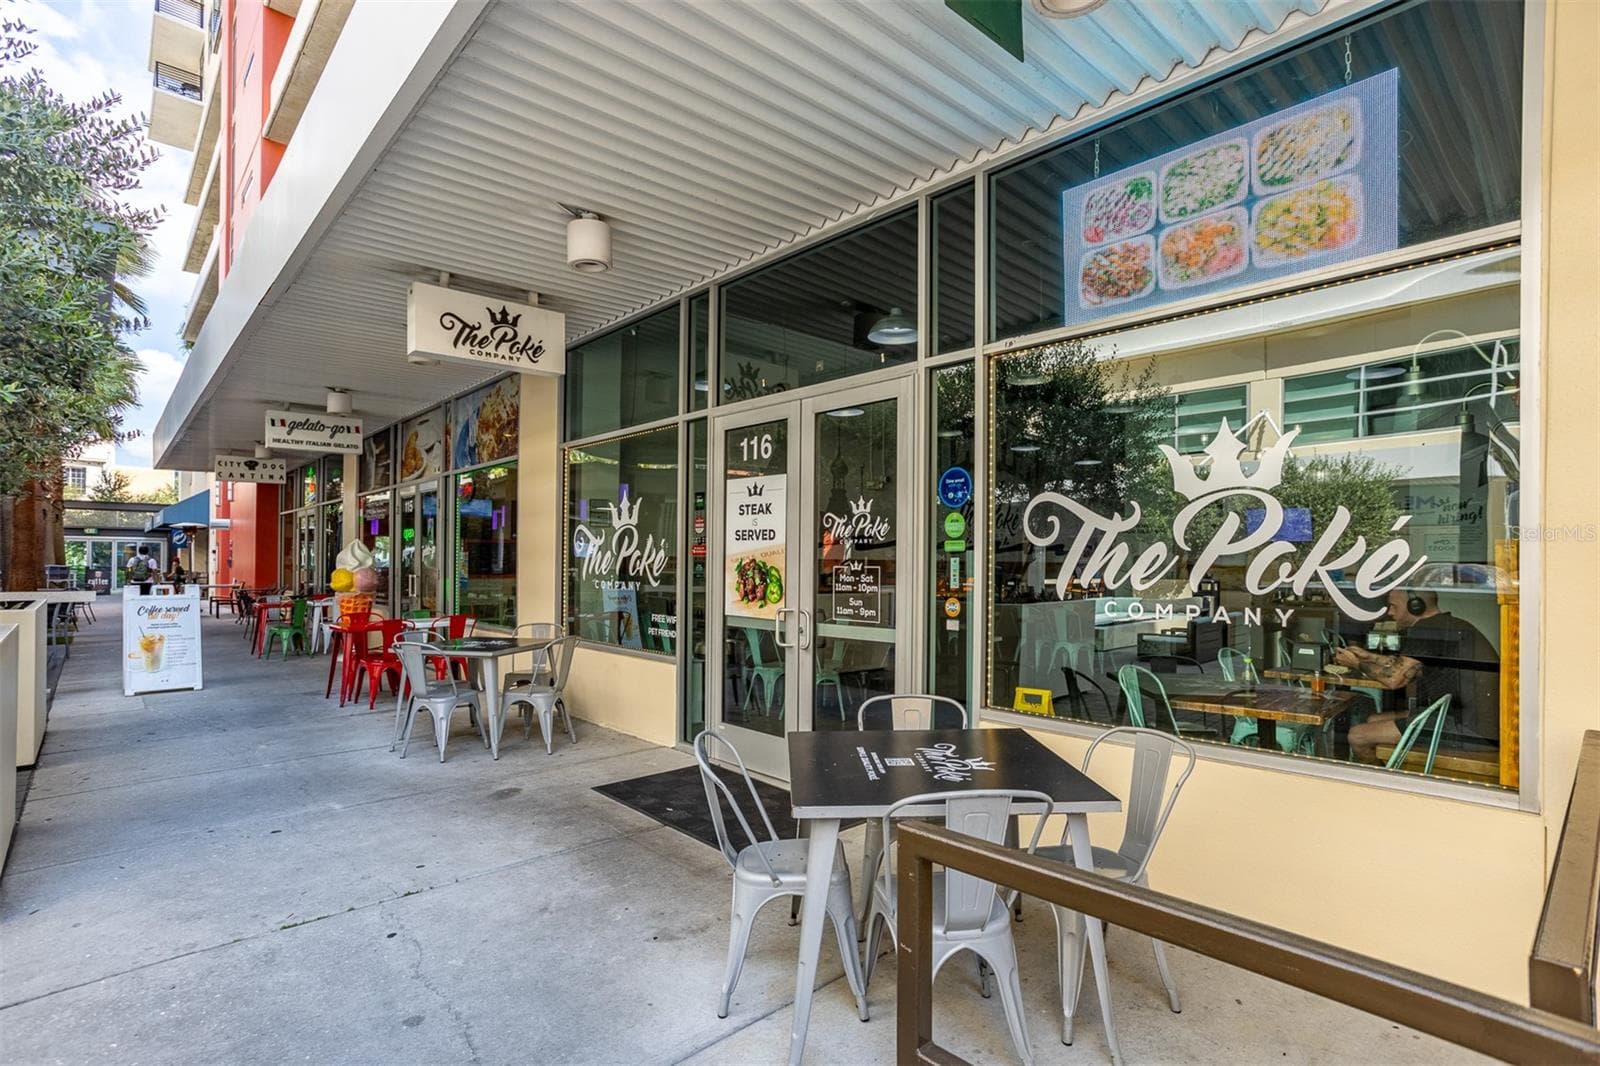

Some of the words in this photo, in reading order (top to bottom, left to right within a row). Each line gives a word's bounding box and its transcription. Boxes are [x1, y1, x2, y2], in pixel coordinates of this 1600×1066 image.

[440, 312, 493, 349] The
[490, 324, 545, 364] Poké
[469, 349, 521, 362] COMPANY
[286, 418, 345, 439] gelato-go
[272, 437, 304, 445] HEALTHY
[305, 440, 332, 448] ITALIAN
[739, 433, 773, 462] 116
[217, 472, 284, 480] CANTINA
[738, 502, 772, 516] STEAK
[823, 512, 854, 544] The
[852, 512, 891, 541] Poké
[735, 528, 776, 542] SERVED
[573, 524, 614, 581] The
[612, 524, 669, 587] Poké
[1023, 491, 1181, 601] The
[1173, 488, 1428, 622] Poké
[839, 573, 855, 582] Mon
[860, 573, 874, 583] Sat
[594, 580, 641, 592] COMPANY
[835, 583, 852, 592] 11am
[858, 583, 878, 594] 10pm
[849, 598, 863, 606] Sun
[137, 605, 161, 616] Coffee
[165, 604, 191, 616] served
[836, 606, 853, 615] 11am
[860, 607, 876, 618] 9pm
[1104, 601, 1294, 629] COMPANY
[651, 613, 666, 623] FREE
[648, 627, 658, 636] PET
